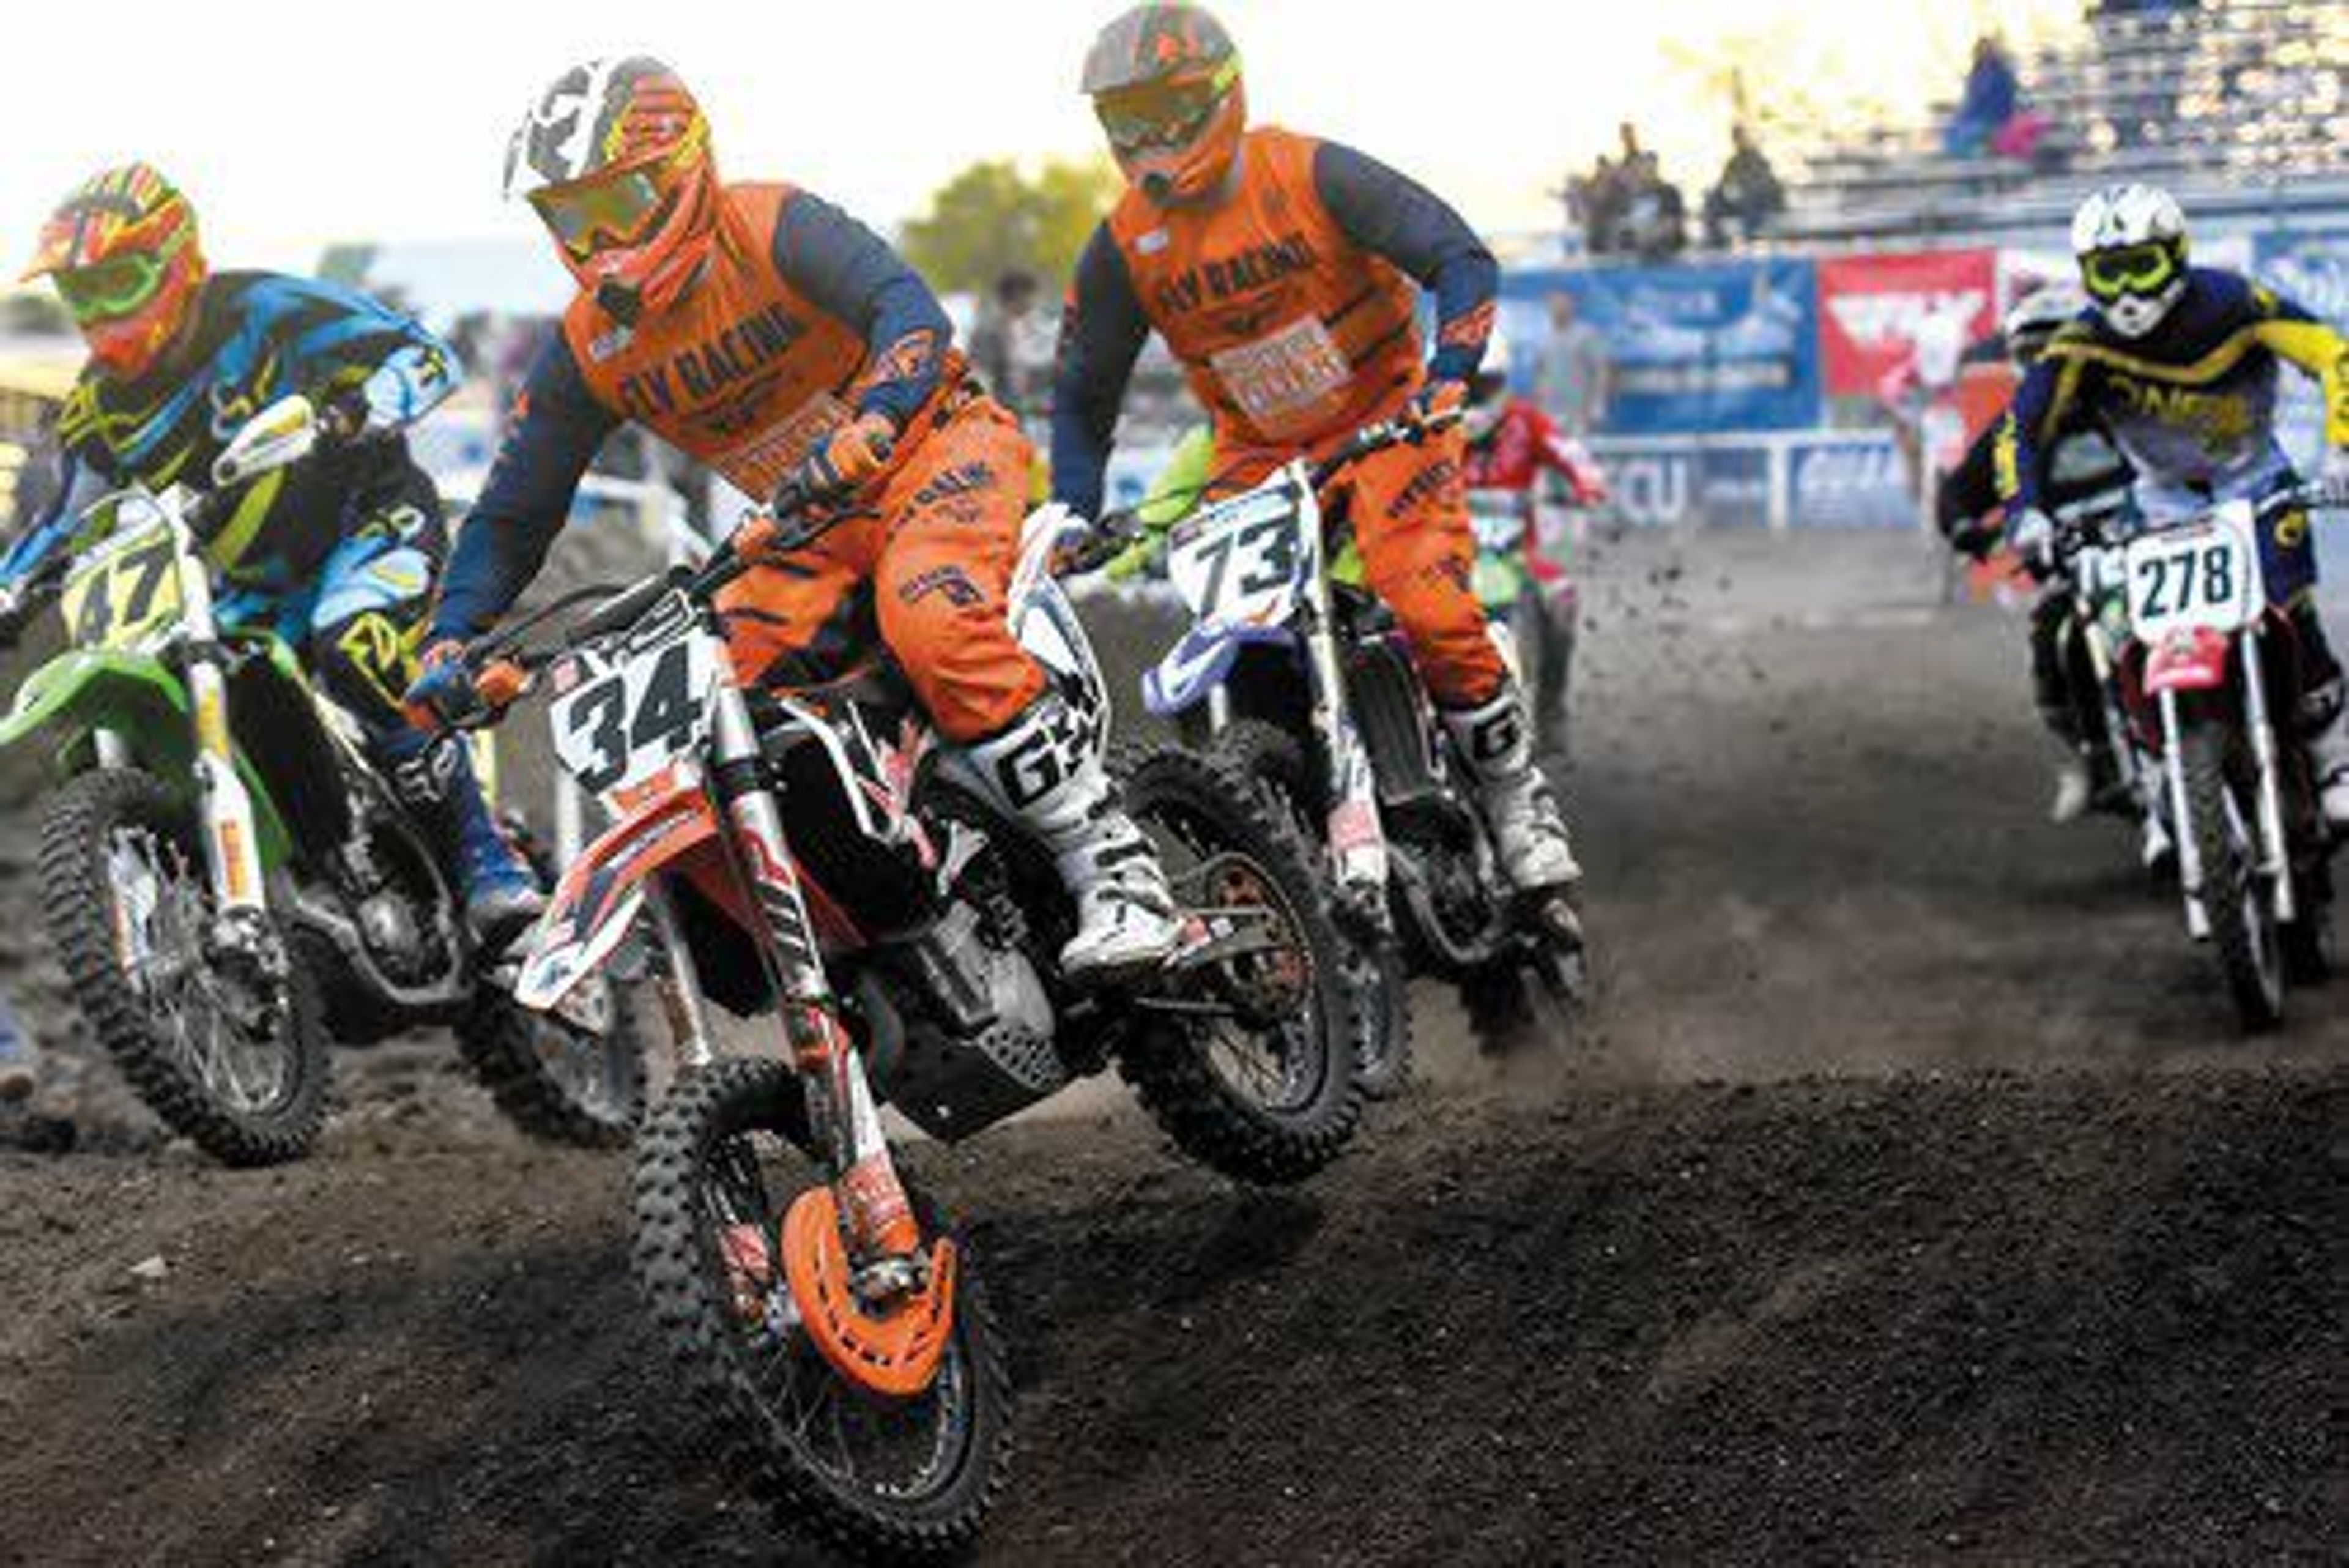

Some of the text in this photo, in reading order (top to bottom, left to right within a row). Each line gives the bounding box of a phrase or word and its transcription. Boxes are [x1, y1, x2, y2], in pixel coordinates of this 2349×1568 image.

[71, 543, 175, 646] 47
[1195, 515, 1299, 620] 73
[2139, 545, 2233, 618] 278
[569, 641, 703, 794] 34
